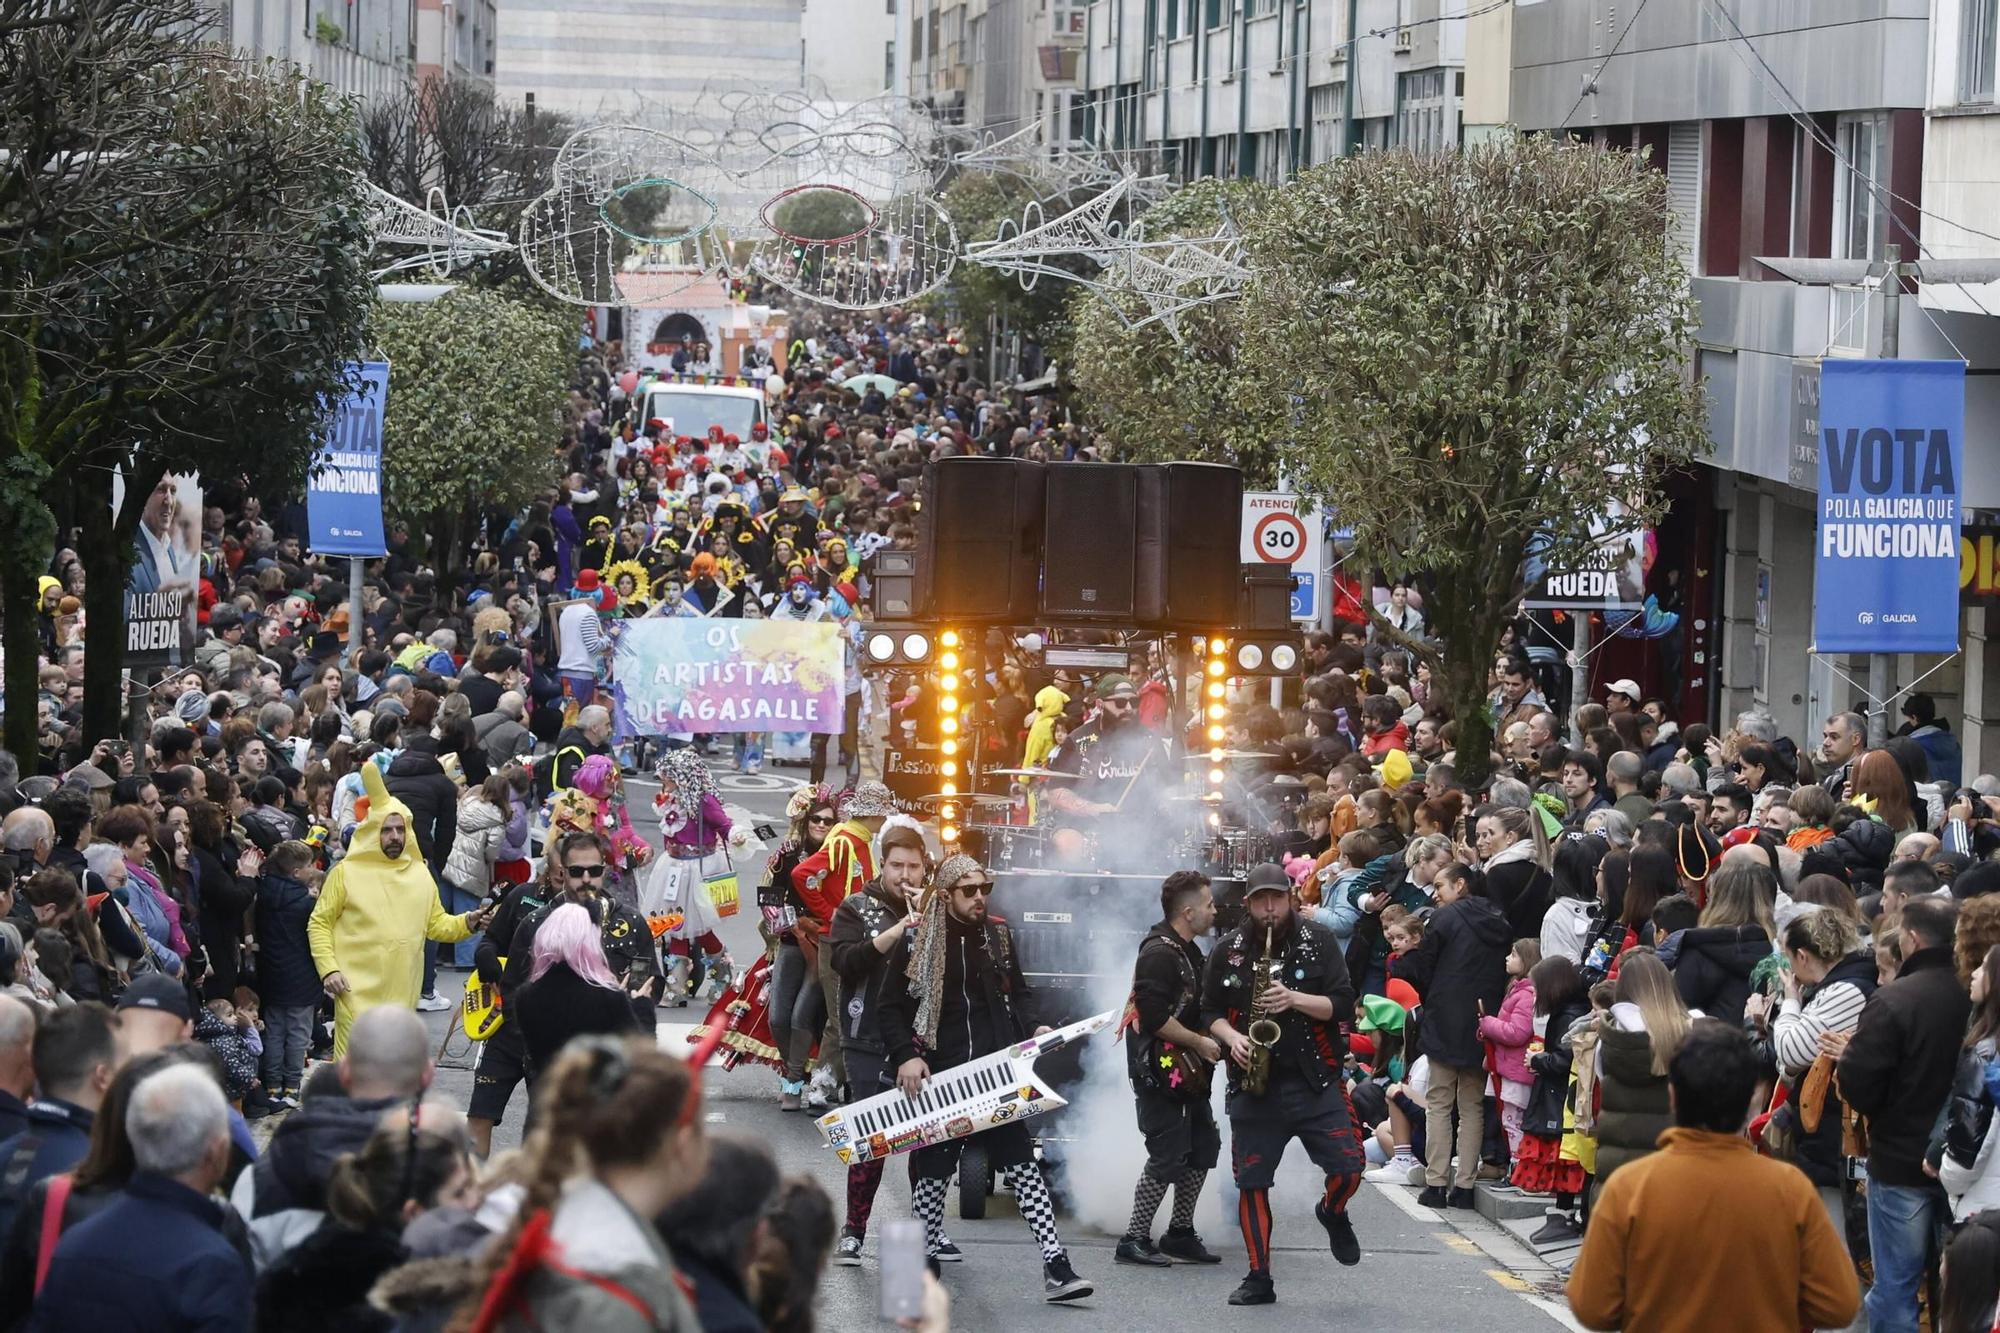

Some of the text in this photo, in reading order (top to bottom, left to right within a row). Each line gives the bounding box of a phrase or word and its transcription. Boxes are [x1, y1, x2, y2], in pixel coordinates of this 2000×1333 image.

[362, 454, 378, 470] QUE
[1823, 427, 1956, 495] VOTA
[1249, 498, 1298, 509] ATENCI
[1825, 497, 1955, 521] POLA GALICIA QUE
[1265, 530, 1295, 548] 30
[1823, 523, 1955, 558] FUNCIONA
[1547, 571, 1620, 597] RUEDA
[129, 592, 182, 619] ALFONSO
[1882, 614, 1917, 623] GALICIA
[128, 619, 180, 651] RUEDA
[706, 625, 741, 651] OS
[636, 697, 819, 724] DE AGASALLE
[669, 874, 677, 888] 2
[828, 1124, 847, 1138] FCK
[830, 1132, 850, 1145] CPS
